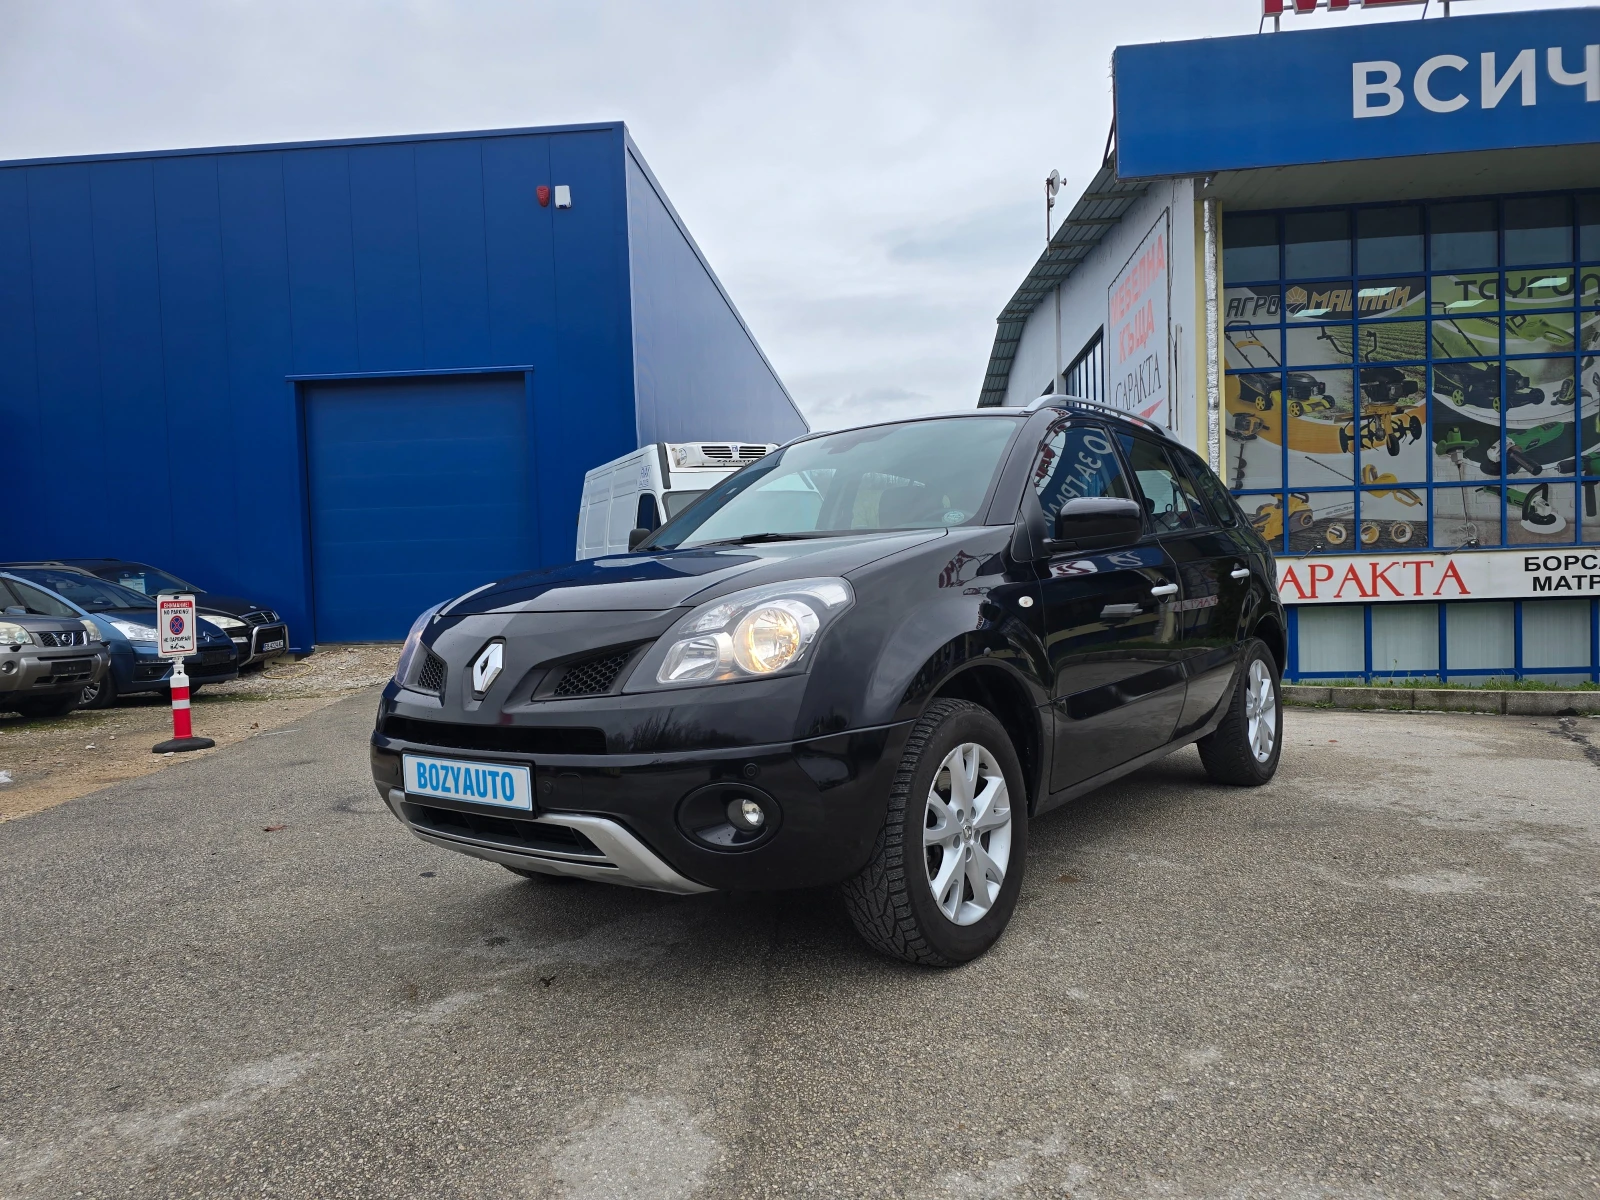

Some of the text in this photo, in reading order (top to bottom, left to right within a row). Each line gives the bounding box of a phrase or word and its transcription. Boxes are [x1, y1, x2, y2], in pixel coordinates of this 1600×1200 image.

[1352, 43, 1600, 119] ВСИЧ
[1111, 233, 1166, 329] МЕБЕЛНА
[1226, 294, 1280, 318] АГРО
[1119, 298, 1155, 364] КЪЩА
[1524, 554, 1600, 572] БОРС
[416, 761, 515, 802] BOZYAUTO
